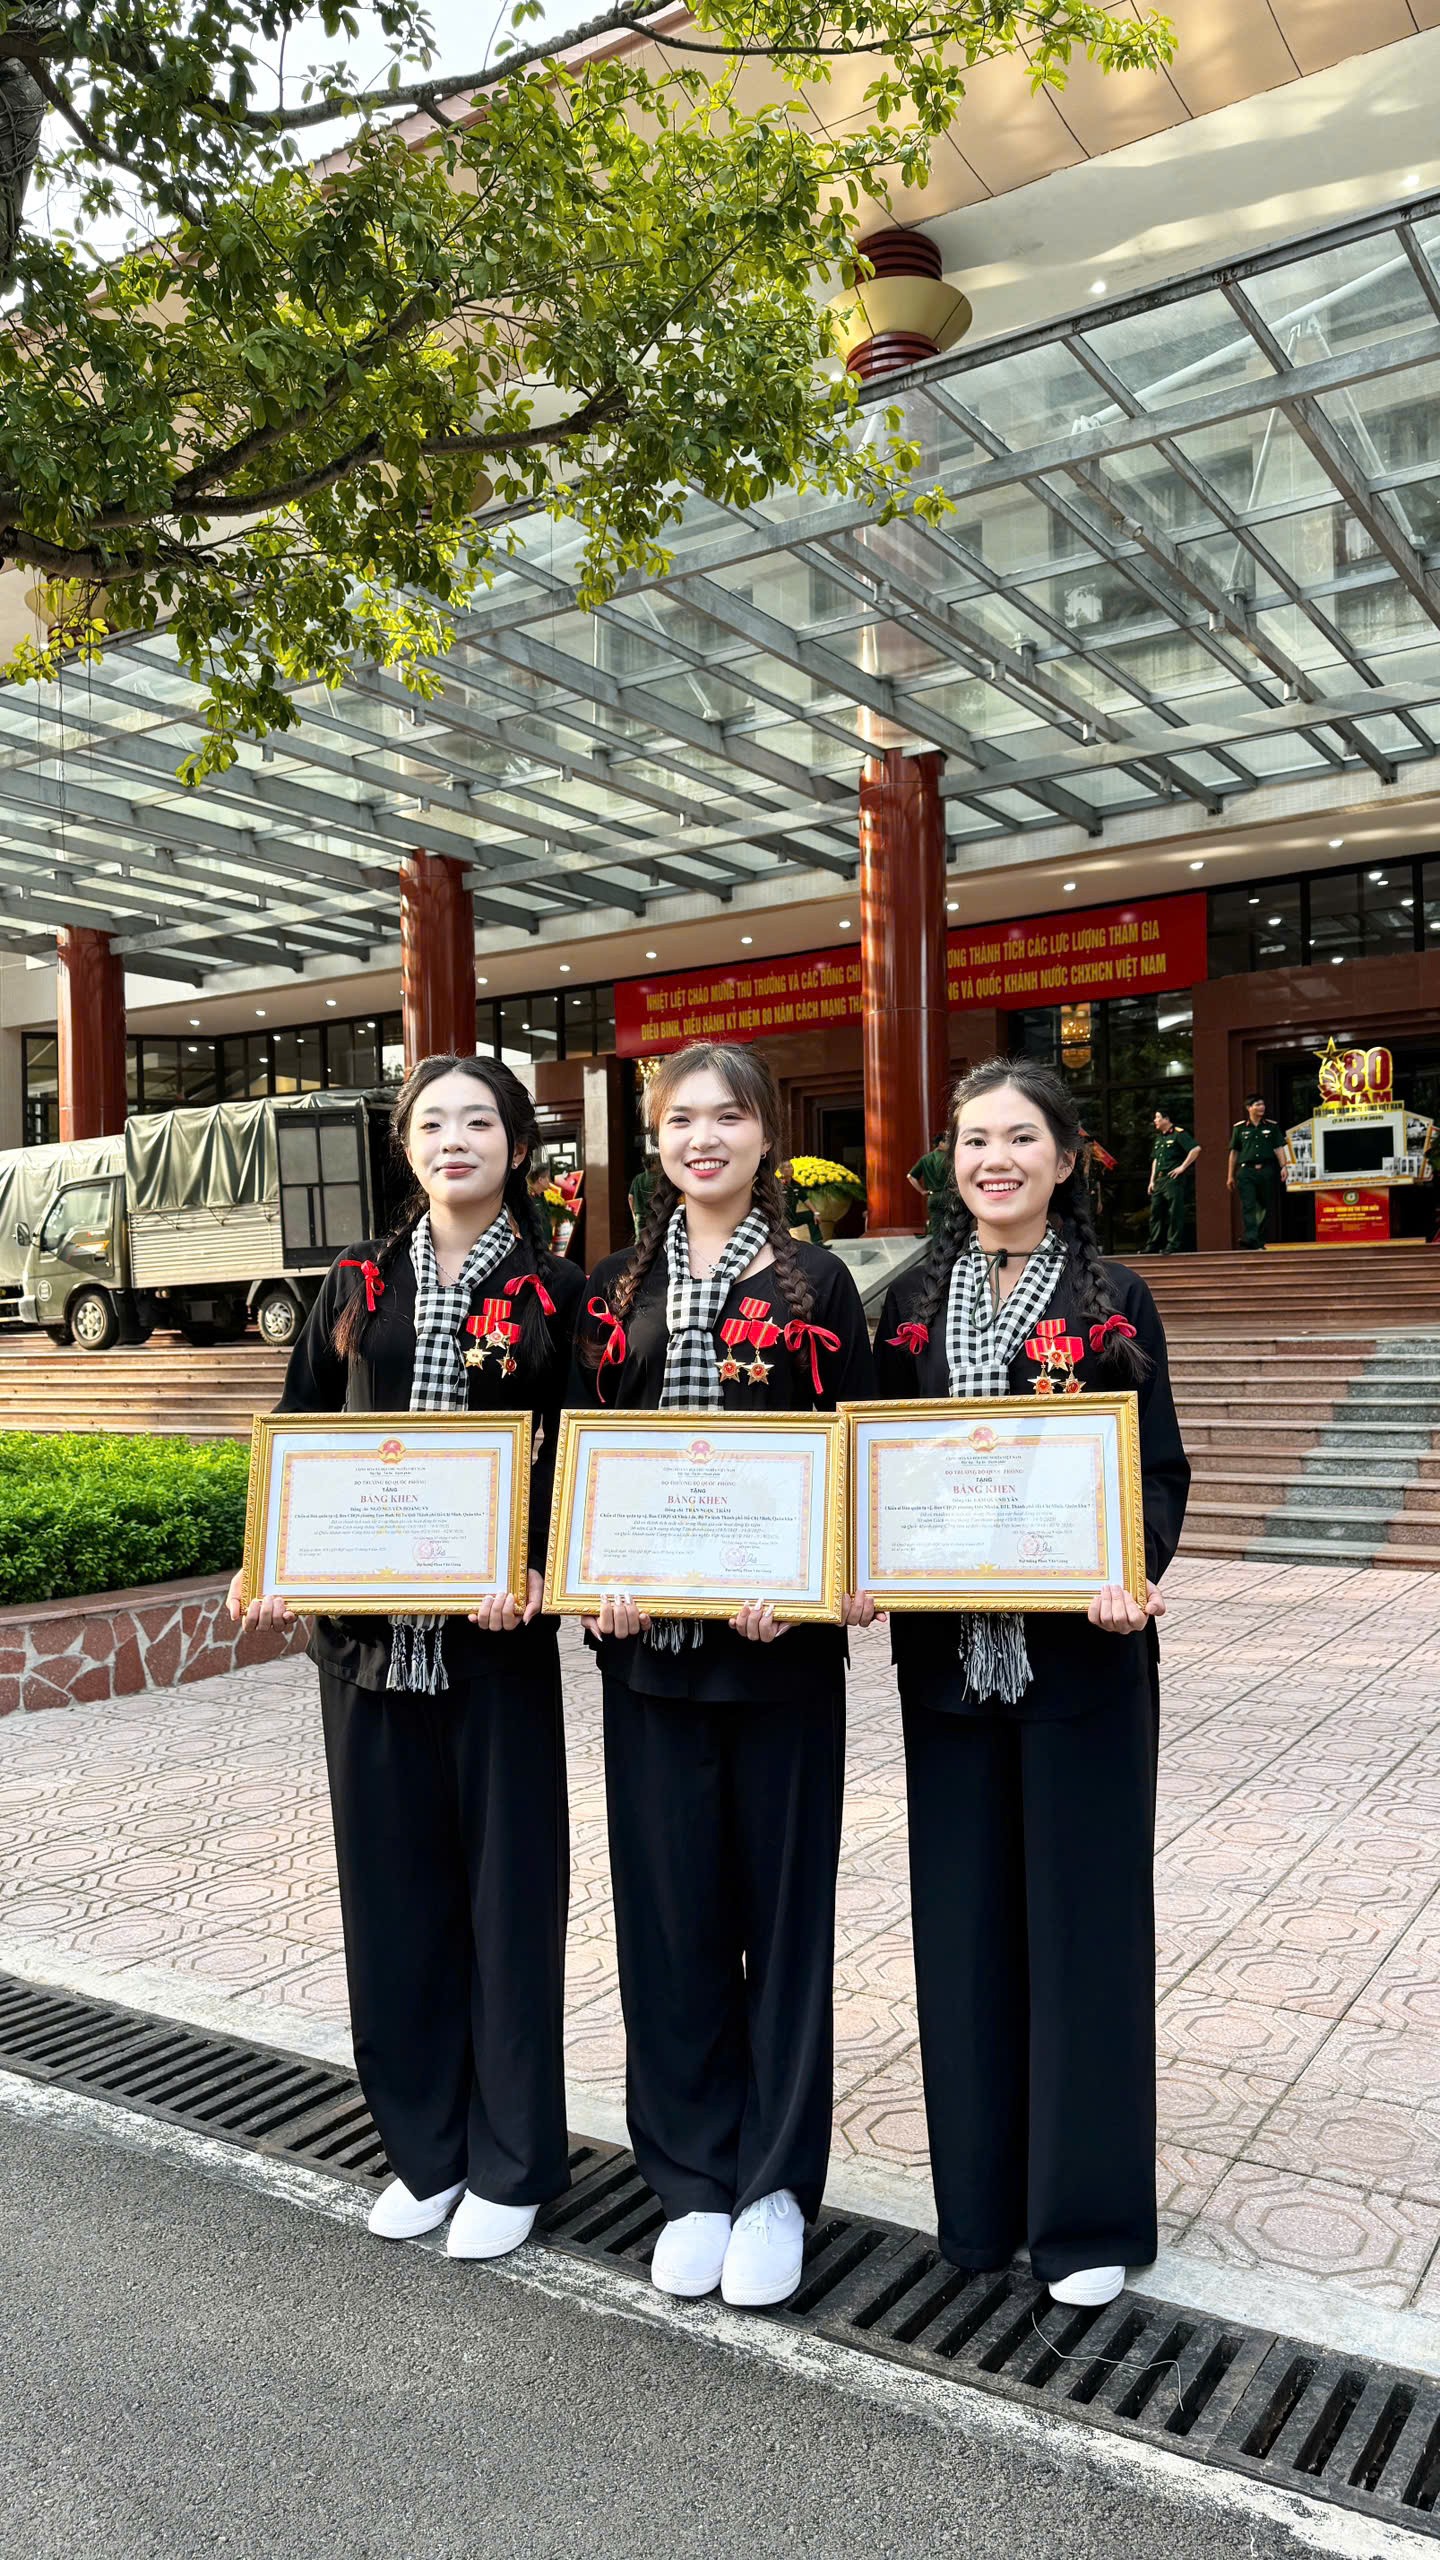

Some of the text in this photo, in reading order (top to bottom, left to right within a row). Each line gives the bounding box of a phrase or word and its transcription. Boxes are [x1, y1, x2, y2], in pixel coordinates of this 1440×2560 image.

[646, 989, 669, 1013] NHIỆT
[670, 987, 686, 1011] LIỆT
[687, 984, 709, 1006] CHÀO
[736, 975, 752, 999] THỦ
[754, 970, 787, 996] TRƯỞNG
[788, 969, 800, 991] VÀ
[801, 967, 819, 990] CÁC
[969, 941, 1001, 966] THÀNH
[1002, 937, 1025, 961] TÍCH
[1027, 933, 1048, 958] CÁC
[1050, 932, 1070, 958] LỰC
[1072, 928, 1106, 954] LƯỢNG
[1108, 922, 1139, 947] THAM
[1141, 919, 1160, 942] GIA
[660, 1020, 682, 1038] BINH,
[702, 1011, 725, 1033] HÀNH
[738, 1006, 760, 1031] NIỆM
[762, 1007, 773, 1025] 80
[773, 1002, 794, 1024] NĂM
[795, 998, 819, 1021] CÁCH
[820, 997, 847, 1020] MẠNG
[961, 976, 974, 999] VÀ
[976, 969, 1002, 999] QUỐC
[1004, 968, 1039, 994] KHÁNH
[1040, 963, 1069, 989] NƯỚC
[1071, 960, 1113, 985] CHXHCN
[1115, 953, 1138, 982] VIỆT
[1140, 952, 1167, 976] NAM
[1343, 1047, 1392, 1092] 80
[390, 1494, 418, 1503] KHEN
[698, 1495, 728, 1505] KHEN
[985, 1484, 1016, 1494] KHEN
